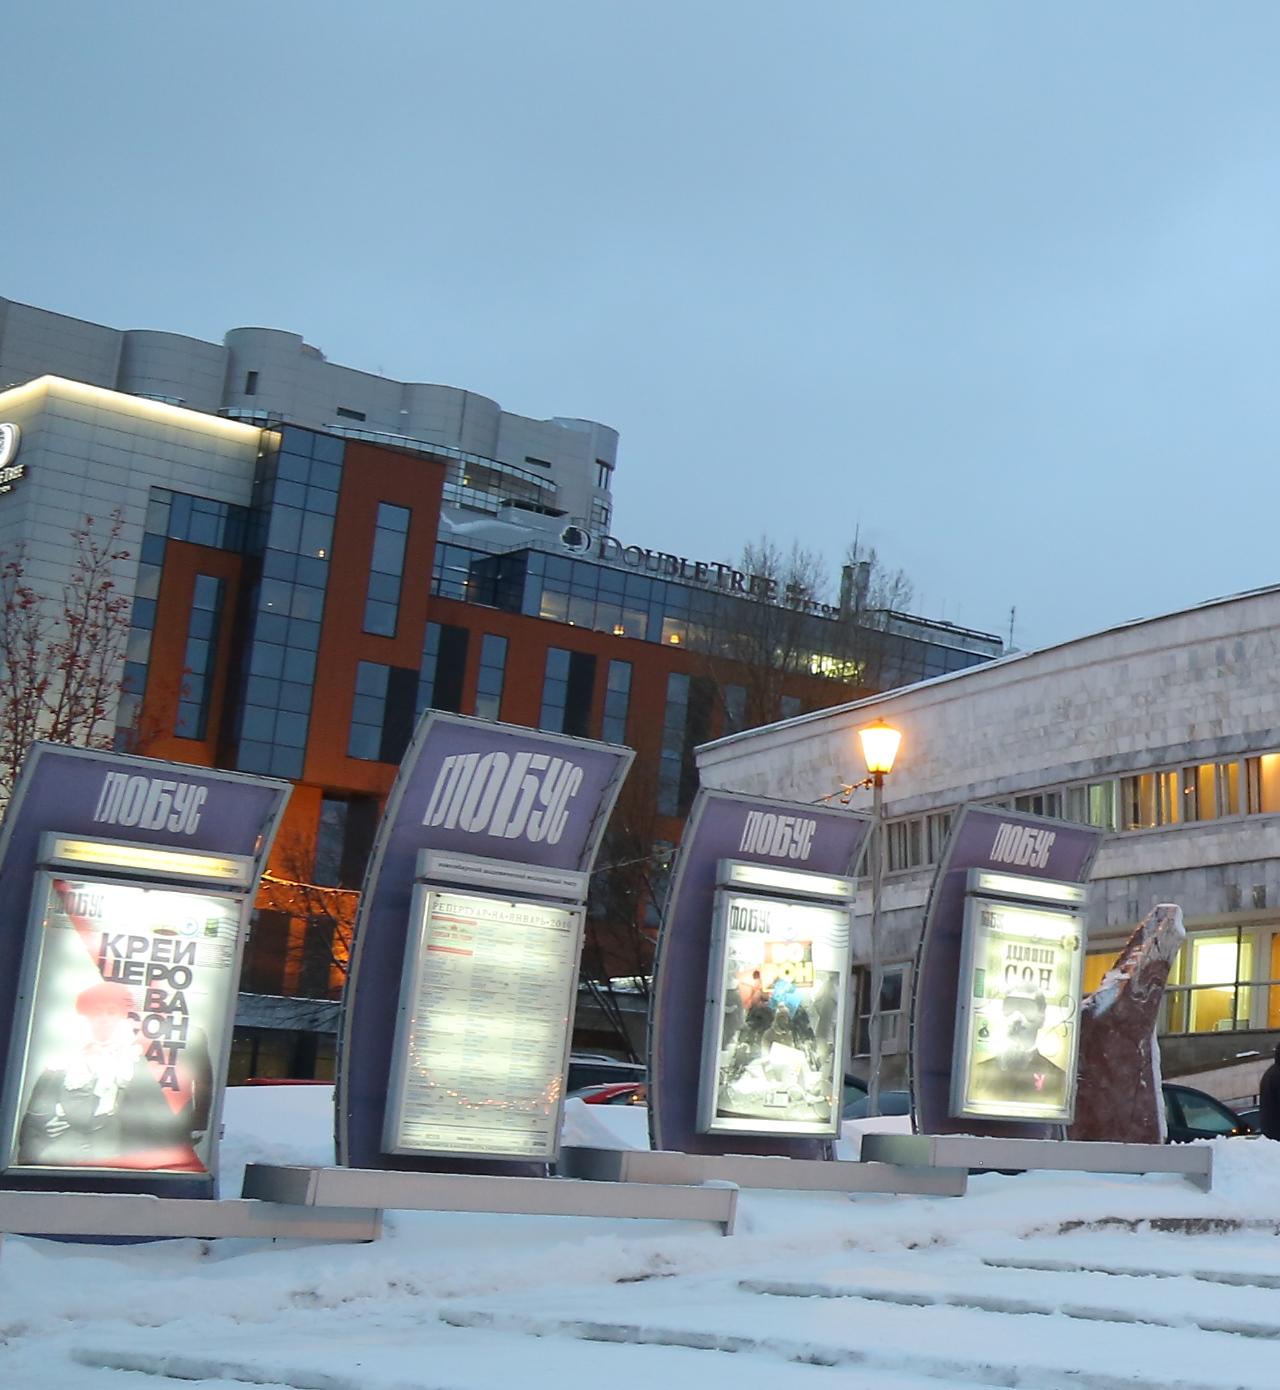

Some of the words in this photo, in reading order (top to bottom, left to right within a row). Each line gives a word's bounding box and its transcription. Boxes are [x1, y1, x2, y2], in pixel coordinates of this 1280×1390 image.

[93, 771, 209, 835] ГЛОБУС
[422, 752, 584, 845] ГЛОБУС
[739, 810, 817, 861] ГЛОБУС
[143, 987, 189, 1015] ВА
